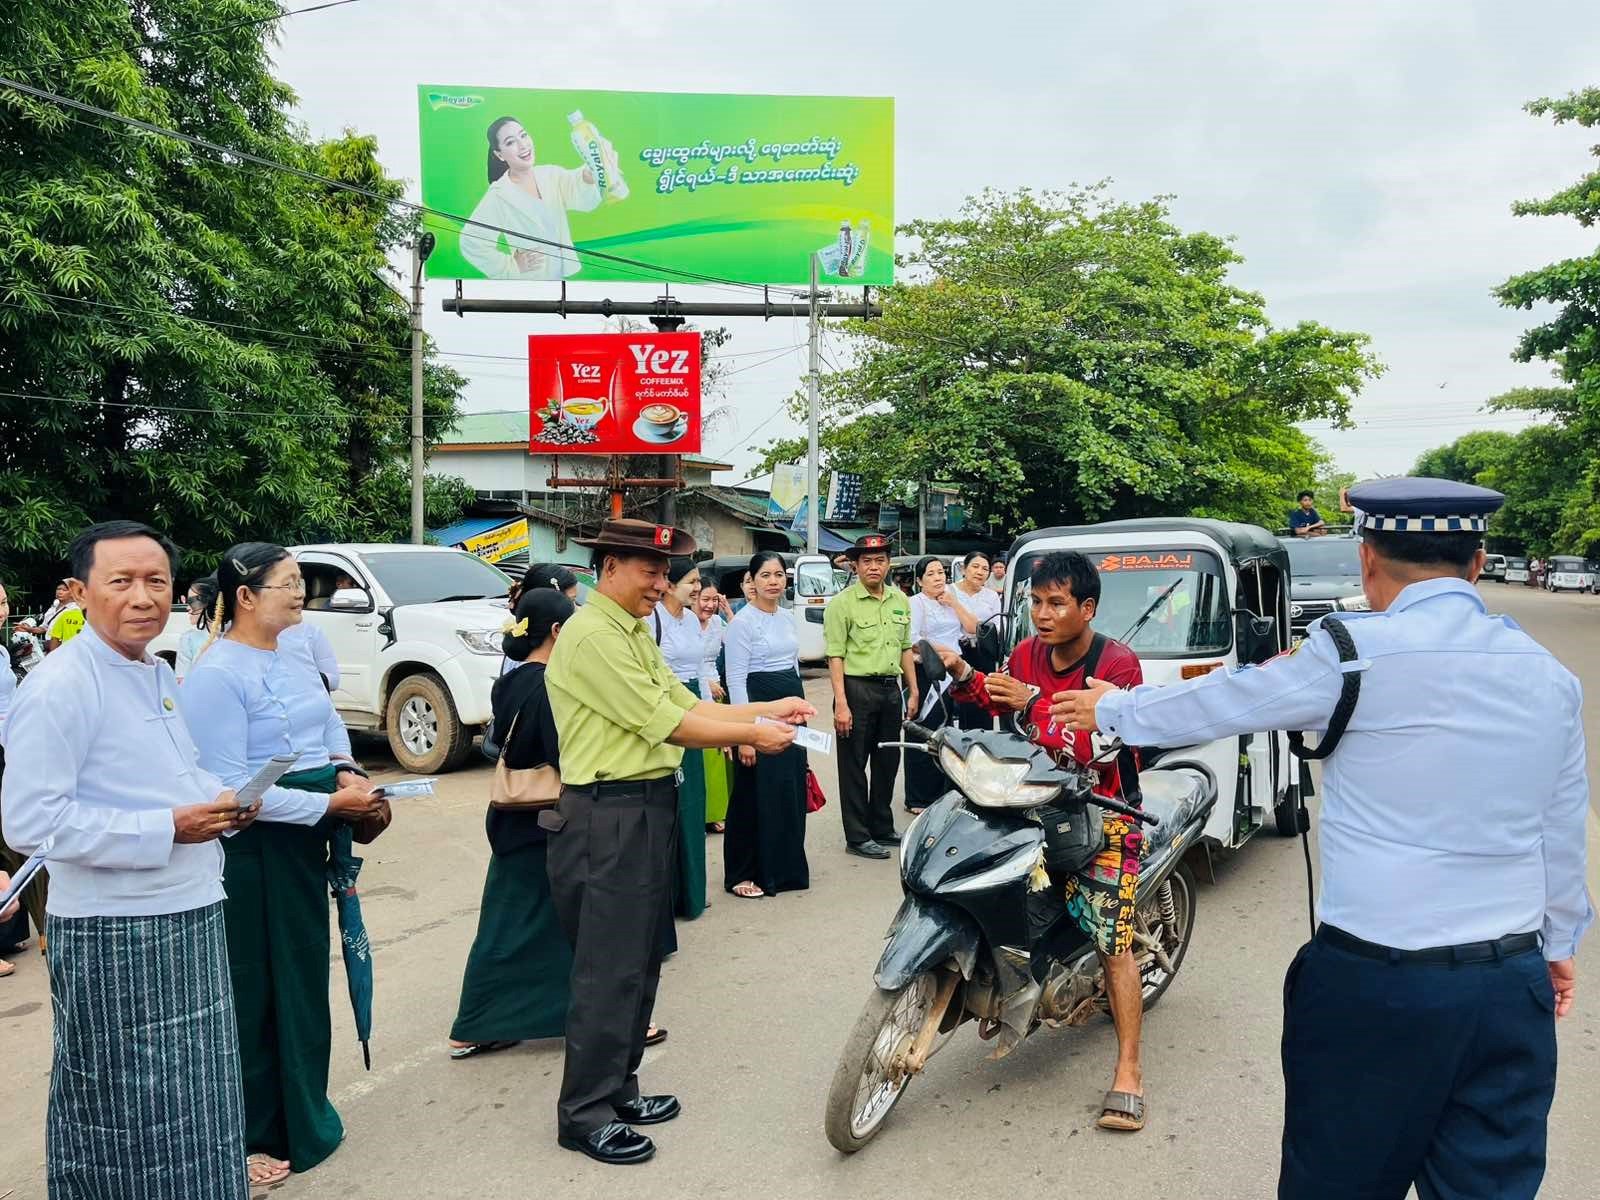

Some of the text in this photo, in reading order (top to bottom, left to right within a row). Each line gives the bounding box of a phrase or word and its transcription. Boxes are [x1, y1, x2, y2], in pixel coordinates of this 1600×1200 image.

[628, 344, 689, 374] Yez
[570, 363, 601, 378] Yez
[640, 377, 684, 385] COFFEEMIX
[1122, 554, 1192, 565] BAJAJ
